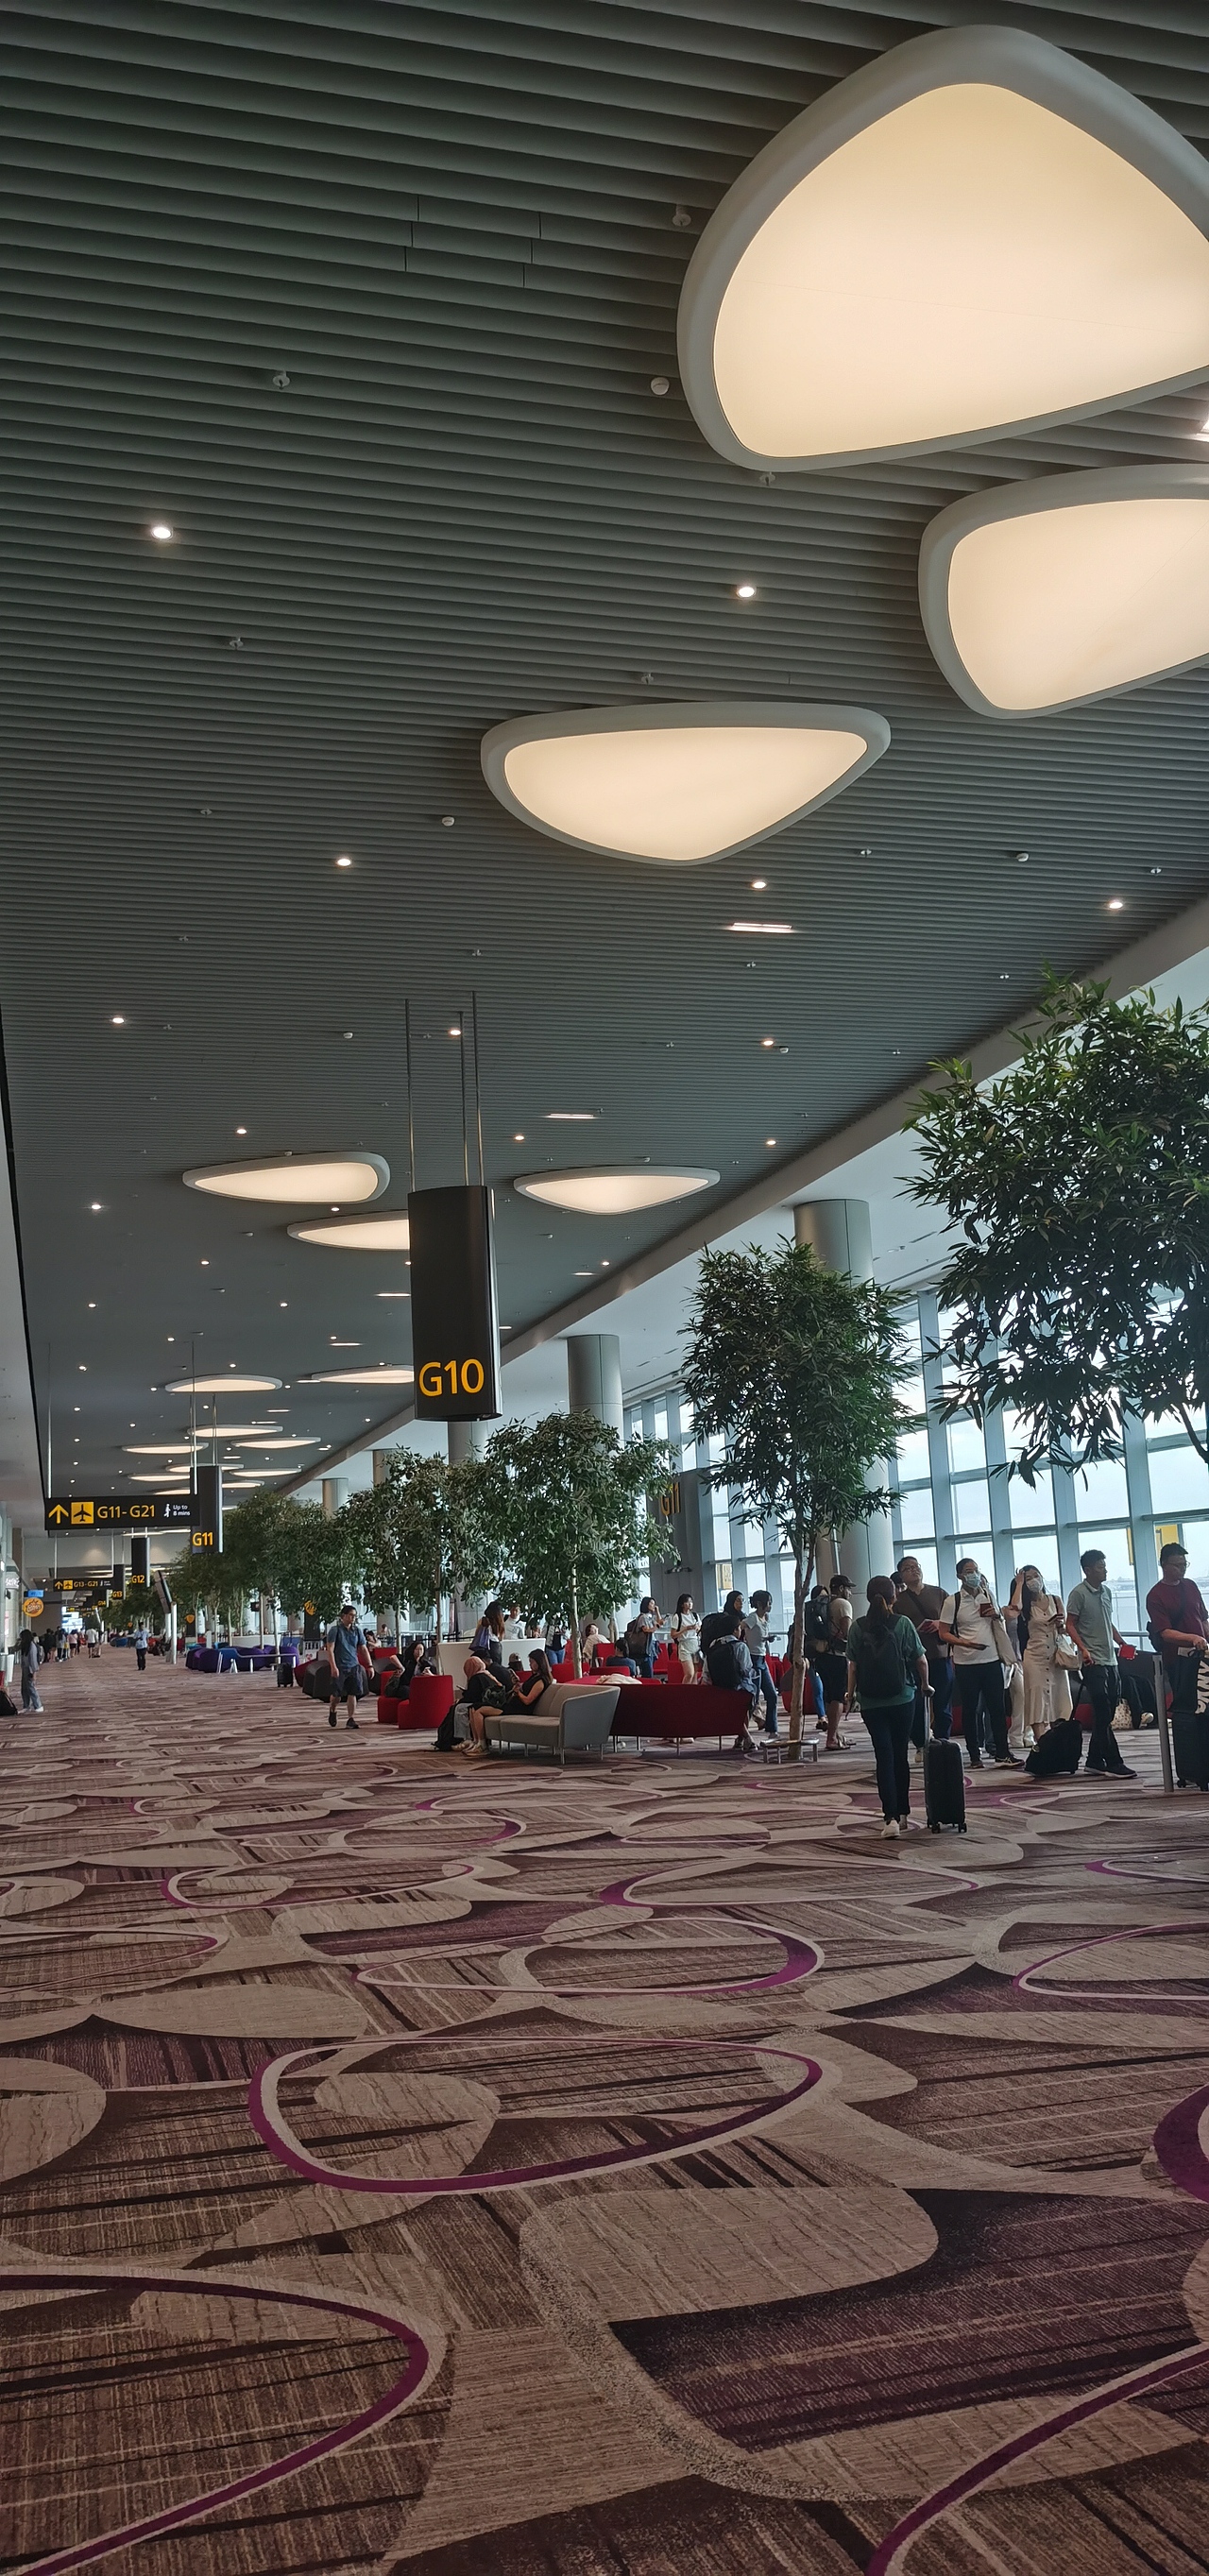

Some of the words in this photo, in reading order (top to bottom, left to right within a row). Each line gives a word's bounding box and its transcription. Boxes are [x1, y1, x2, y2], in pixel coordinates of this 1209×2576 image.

[418, 1358, 485, 1397] G10
[192, 1532, 213, 1546] G11
[131, 1575, 145, 1584] G12
